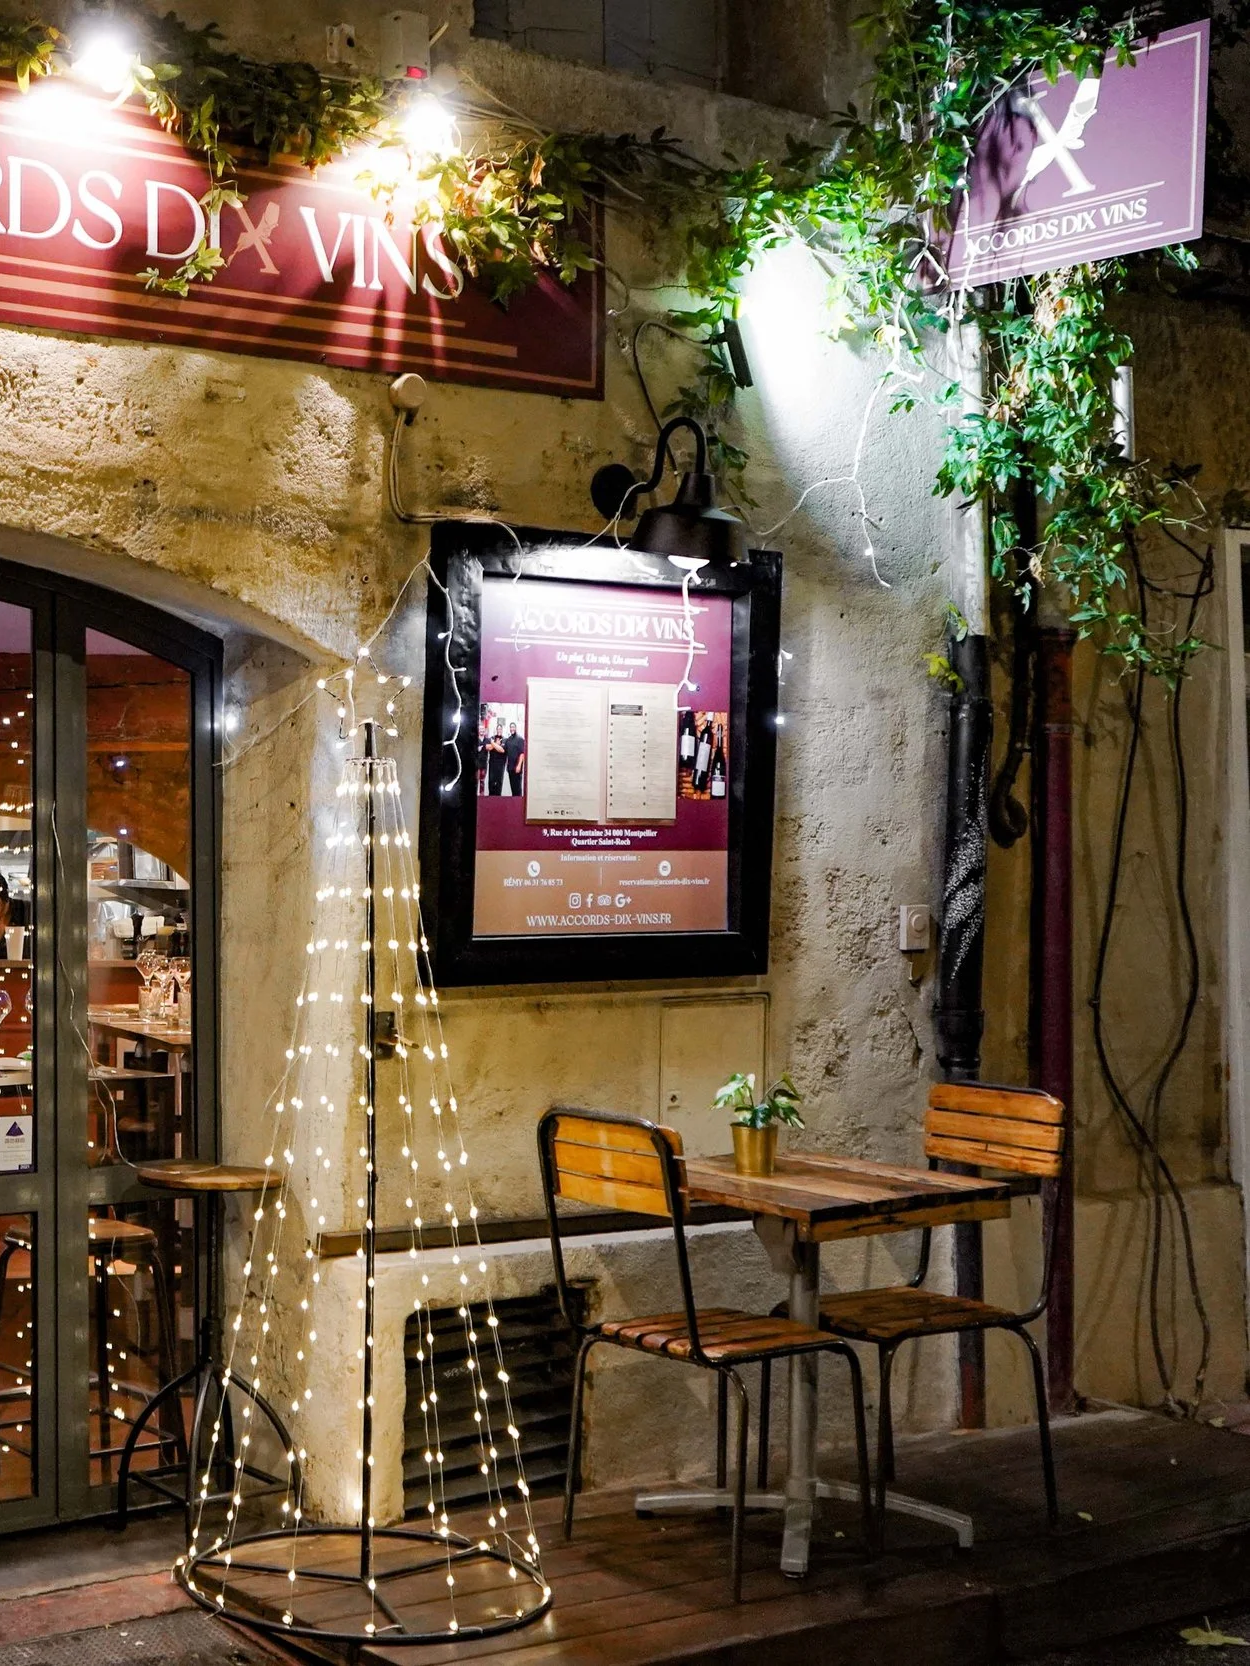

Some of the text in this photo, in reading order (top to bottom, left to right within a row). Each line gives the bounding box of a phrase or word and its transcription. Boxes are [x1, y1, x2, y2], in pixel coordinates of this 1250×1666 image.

[963, 197, 1148, 259] ACCORDS DIX VINS
[299, 203, 466, 302] VINS
[510, 607, 696, 641] ACCORDS DIX VINS
[542, 829, 550, 837] 9,
[550, 829, 563, 837] Rue
[563, 829, 572, 837] de
[572, 829, 579, 837] la
[579, 829, 604, 837] fontaine
[604, 829, 612, 837] 34
[624, 829, 658, 838] Montpellier
[571, 838, 631, 847] Quartier Saint-Roch
[526, 914, 672, 927] WWW.ACCORDS-DIX-VINS.FR
